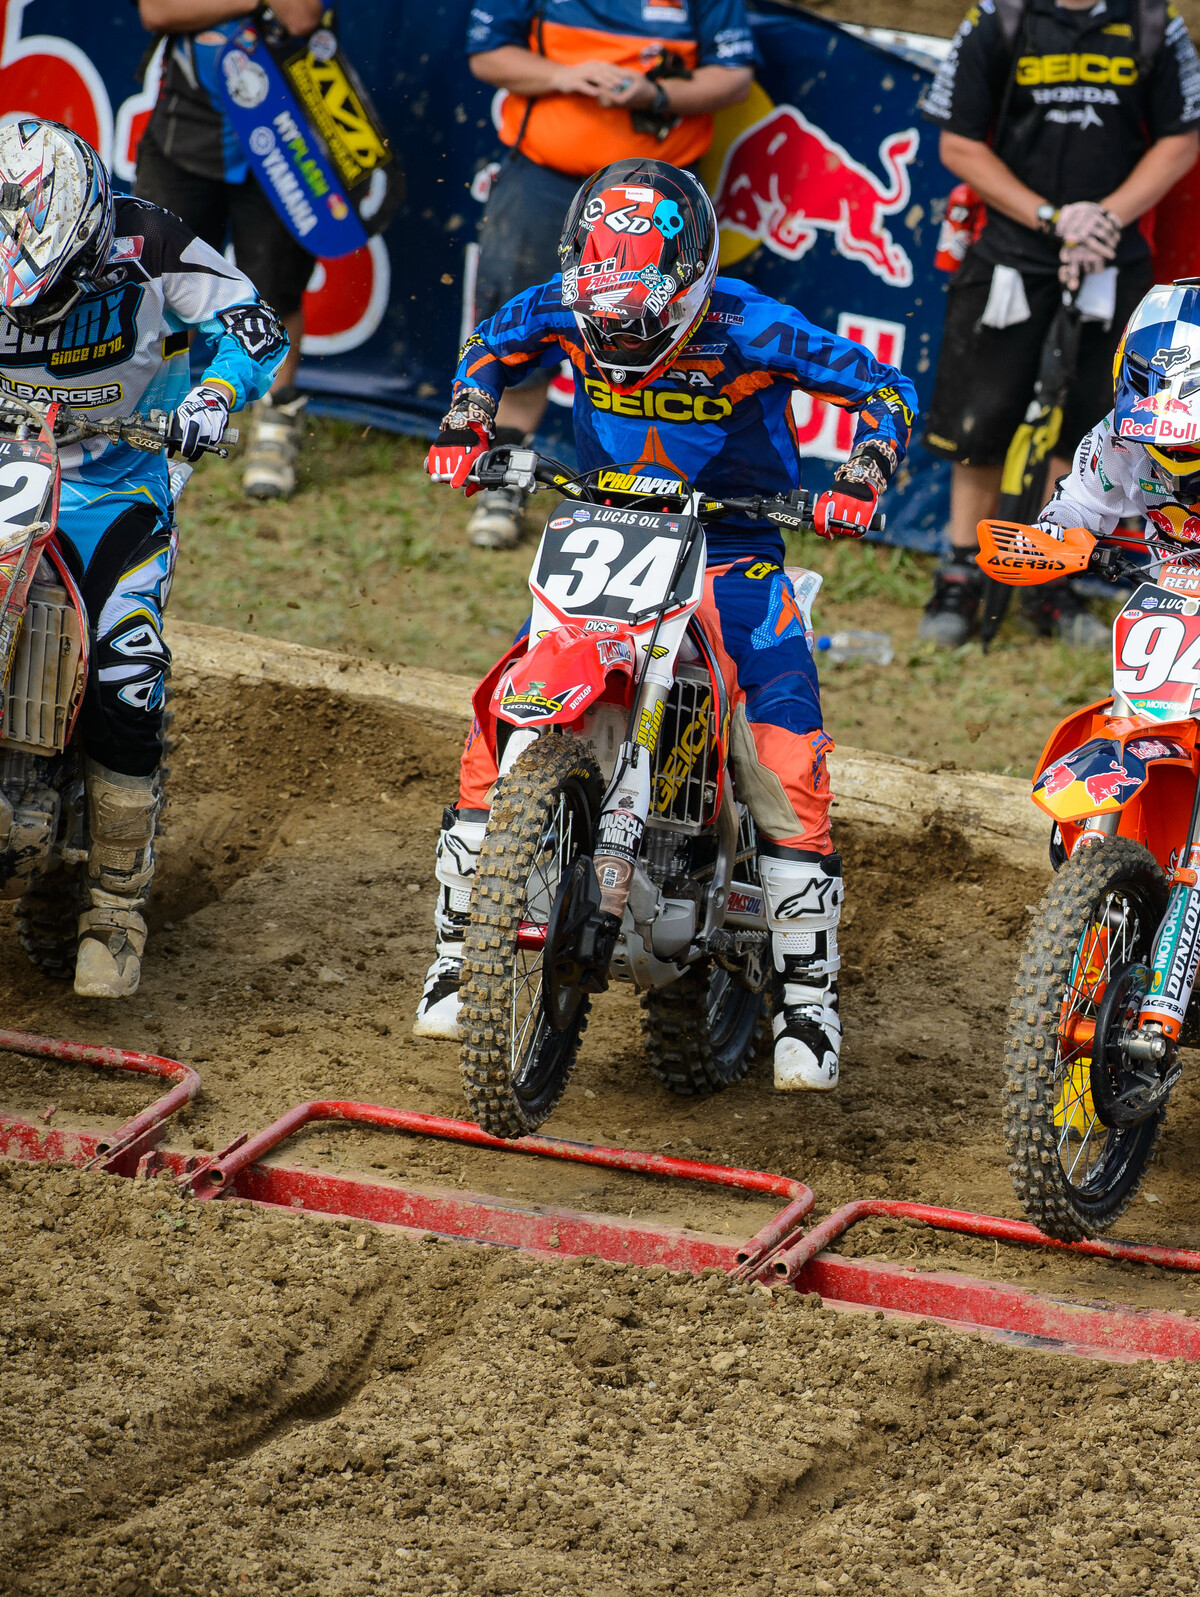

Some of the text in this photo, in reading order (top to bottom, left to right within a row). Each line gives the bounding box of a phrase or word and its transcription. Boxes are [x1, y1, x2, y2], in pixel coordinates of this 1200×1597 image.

[1016, 53, 1138, 86] GEICO
[1031, 86, 1121, 105] HONDA
[261, 153, 319, 237] YAMAHA
[578, 218, 596, 232] VIRUS
[605, 204, 651, 234] 6D
[563, 268, 577, 292] DVS
[587, 271, 640, 290] AMSOIL
[589, 305, 629, 316] HONDA
[646, 285, 668, 314] DVS
[0, 378, 119, 403] ILBARGER
[584, 376, 733, 421] GEICO
[1120, 418, 1197, 440] Red Bull
[128, 435, 163, 450] ARC
[594, 510, 661, 529] LUCAS OIL
[768, 512, 801, 527] ARC
[544, 527, 690, 615] 34
[1158, 598, 1200, 612] LUC
[585, 621, 607, 632] DVS
[598, 641, 633, 664] AMSOIL
[500, 694, 563, 713] GEICO
[569, 685, 592, 710] DUNLOP
[506, 705, 548, 715] HONDA
[599, 813, 643, 840] MUSCLE
[603, 828, 635, 850] MILK
[728, 892, 761, 914] AMSOIL
